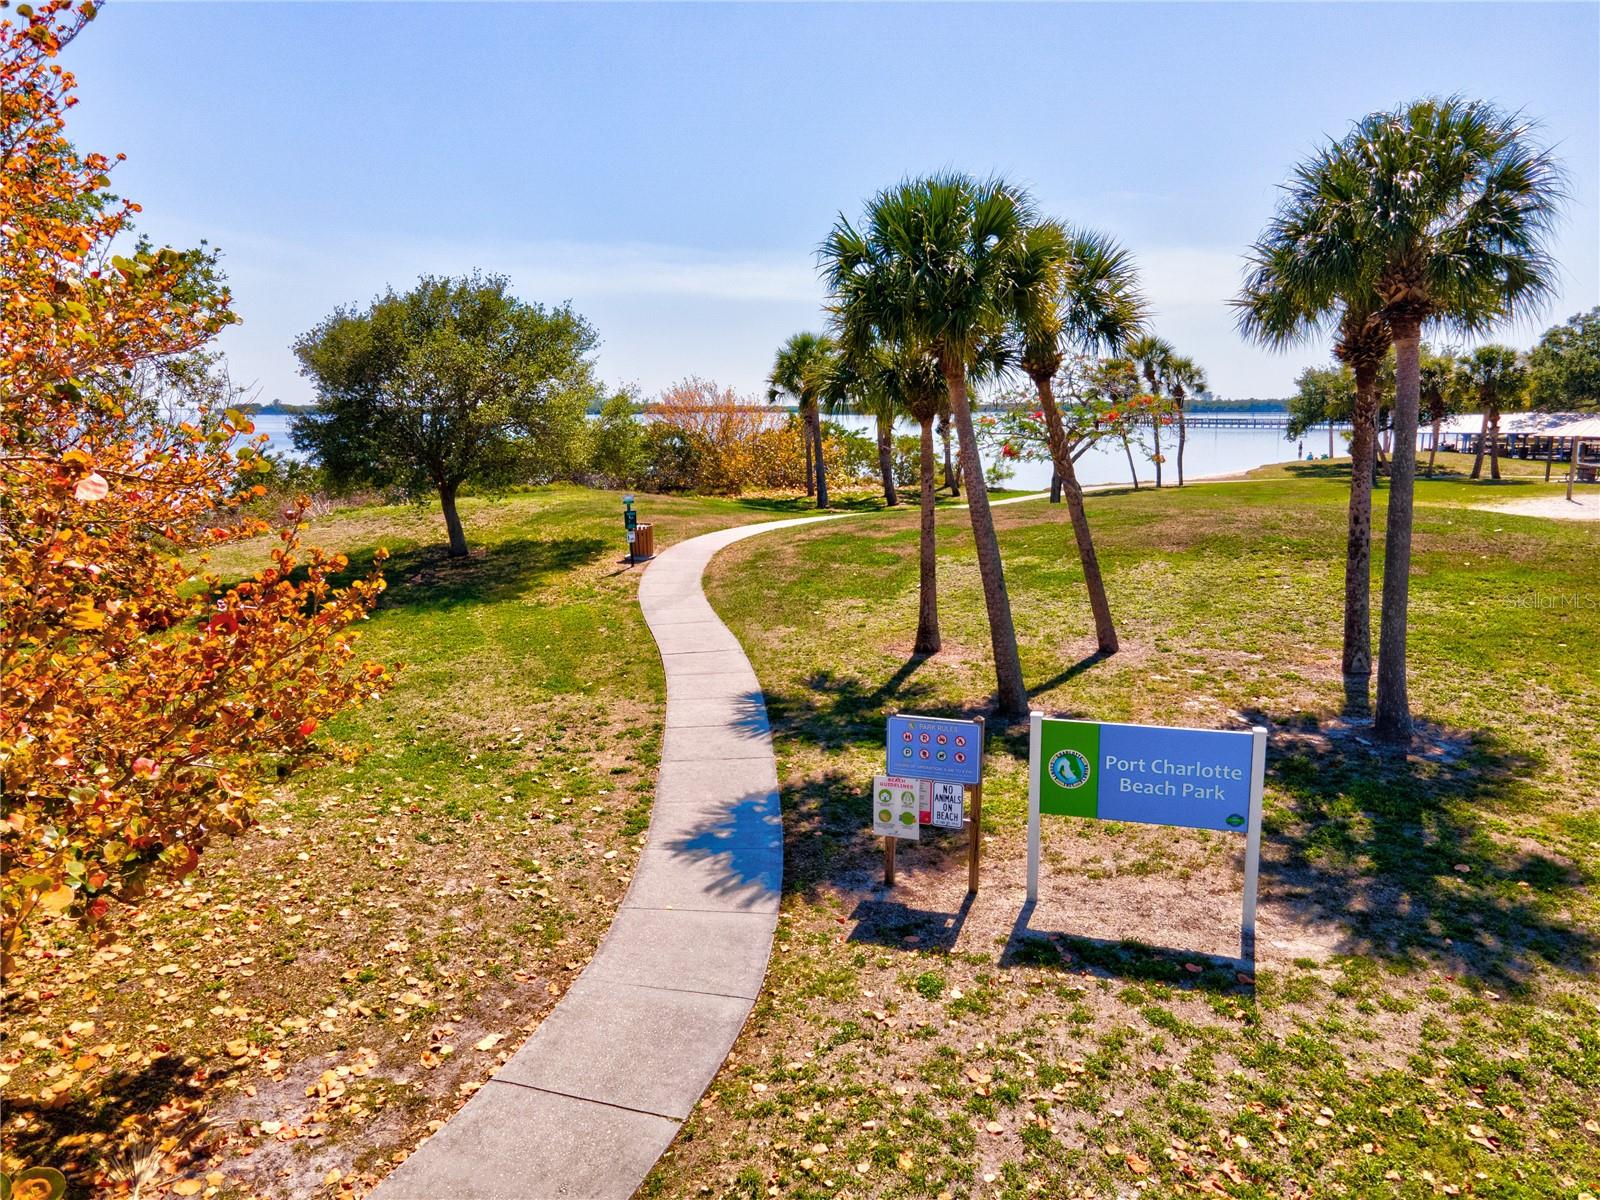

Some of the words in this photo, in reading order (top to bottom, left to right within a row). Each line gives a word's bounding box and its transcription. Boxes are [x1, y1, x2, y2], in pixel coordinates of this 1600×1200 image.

[920, 723, 937, 731] PARK
[1105, 755, 1146, 773] Port
[1151, 759, 1242, 781] Charlotte
[943, 784, 953, 794] NO
[1120, 777, 1176, 796] Beach
[1182, 783, 1226, 801] Park
[935, 794, 962, 804] ANIMALS
[943, 803, 953, 812] ON
[937, 811, 959, 822] BEACH
